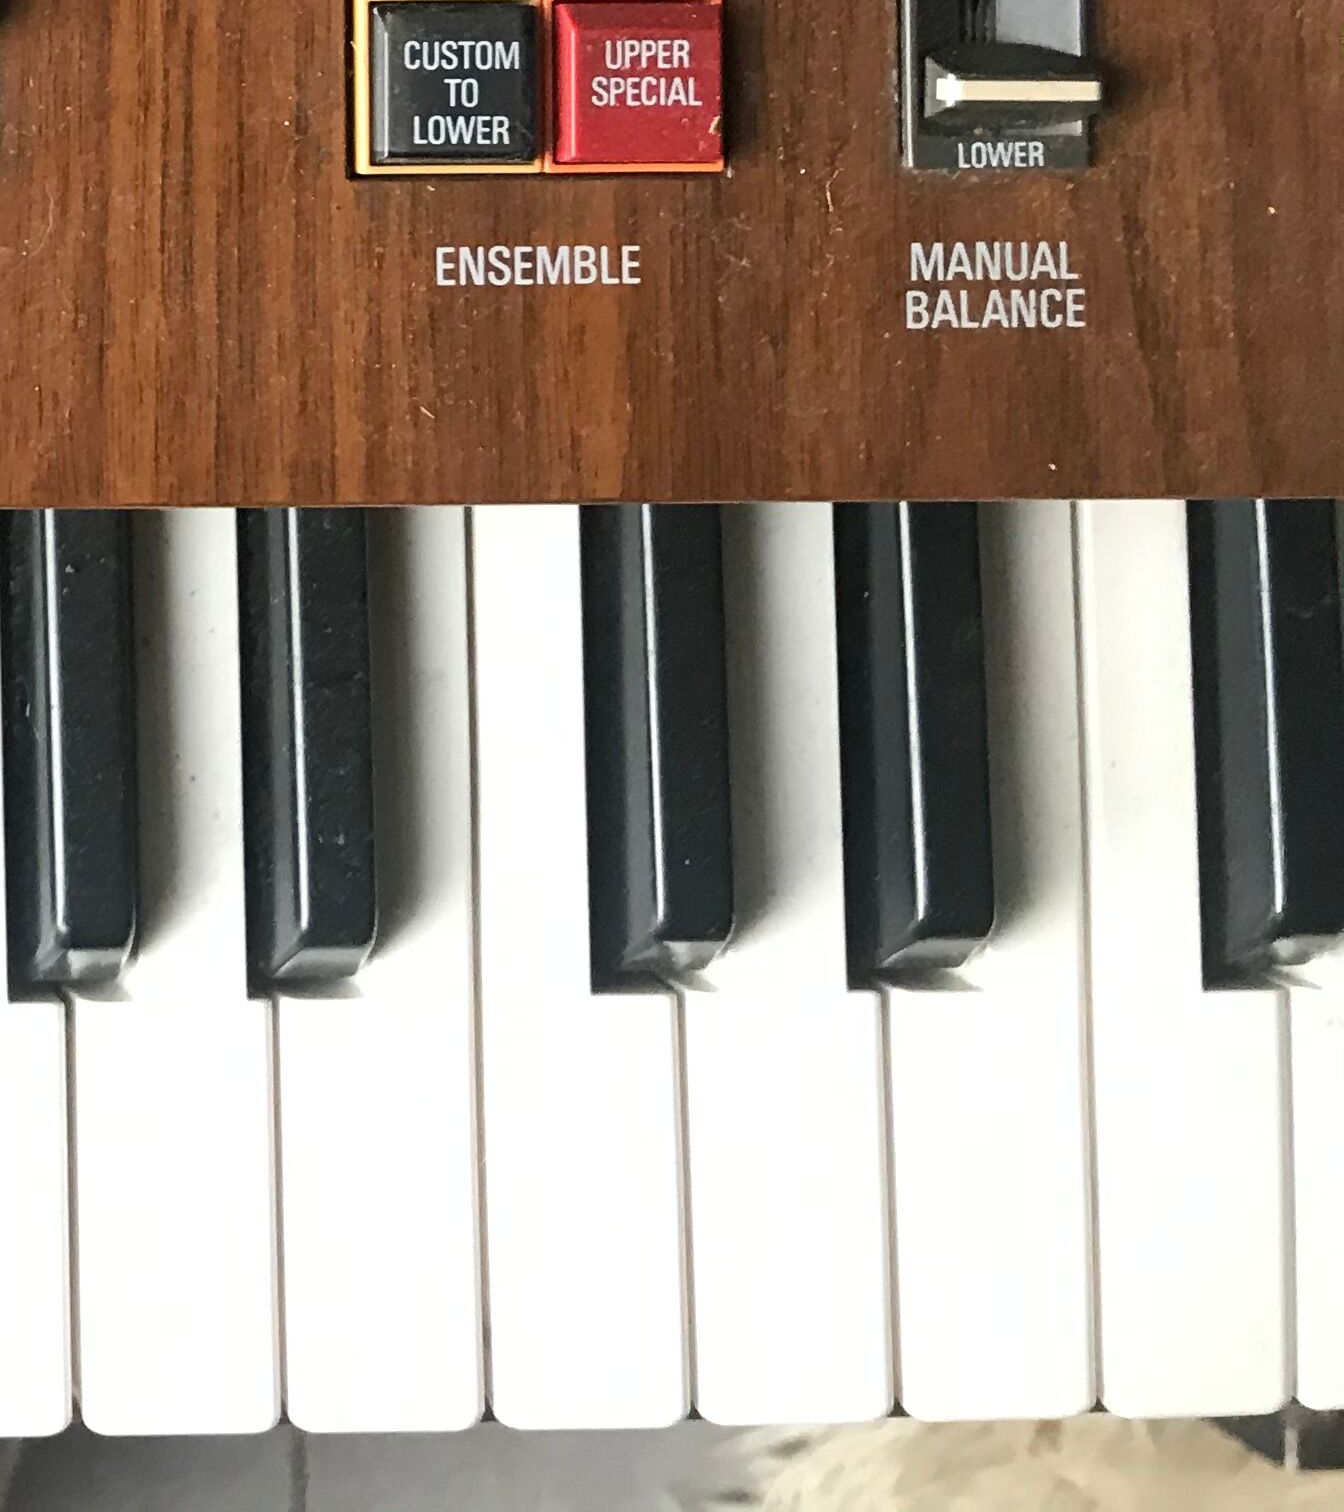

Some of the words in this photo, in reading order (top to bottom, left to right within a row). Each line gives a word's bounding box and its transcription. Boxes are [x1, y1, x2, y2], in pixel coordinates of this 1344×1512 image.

[403, 40, 520, 71] CUSTOM
[605, 39, 690, 70] UPPER
[443, 77, 479, 108] TO
[591, 76, 703, 107] SPECIAL
[413, 115, 510, 145] LOWER
[957, 140, 1045, 169] LOWER
[436, 245, 641, 286] ENSEMBLE
[910, 241, 1079, 282] MANUAL
[905, 288, 1086, 330] BALANCE
